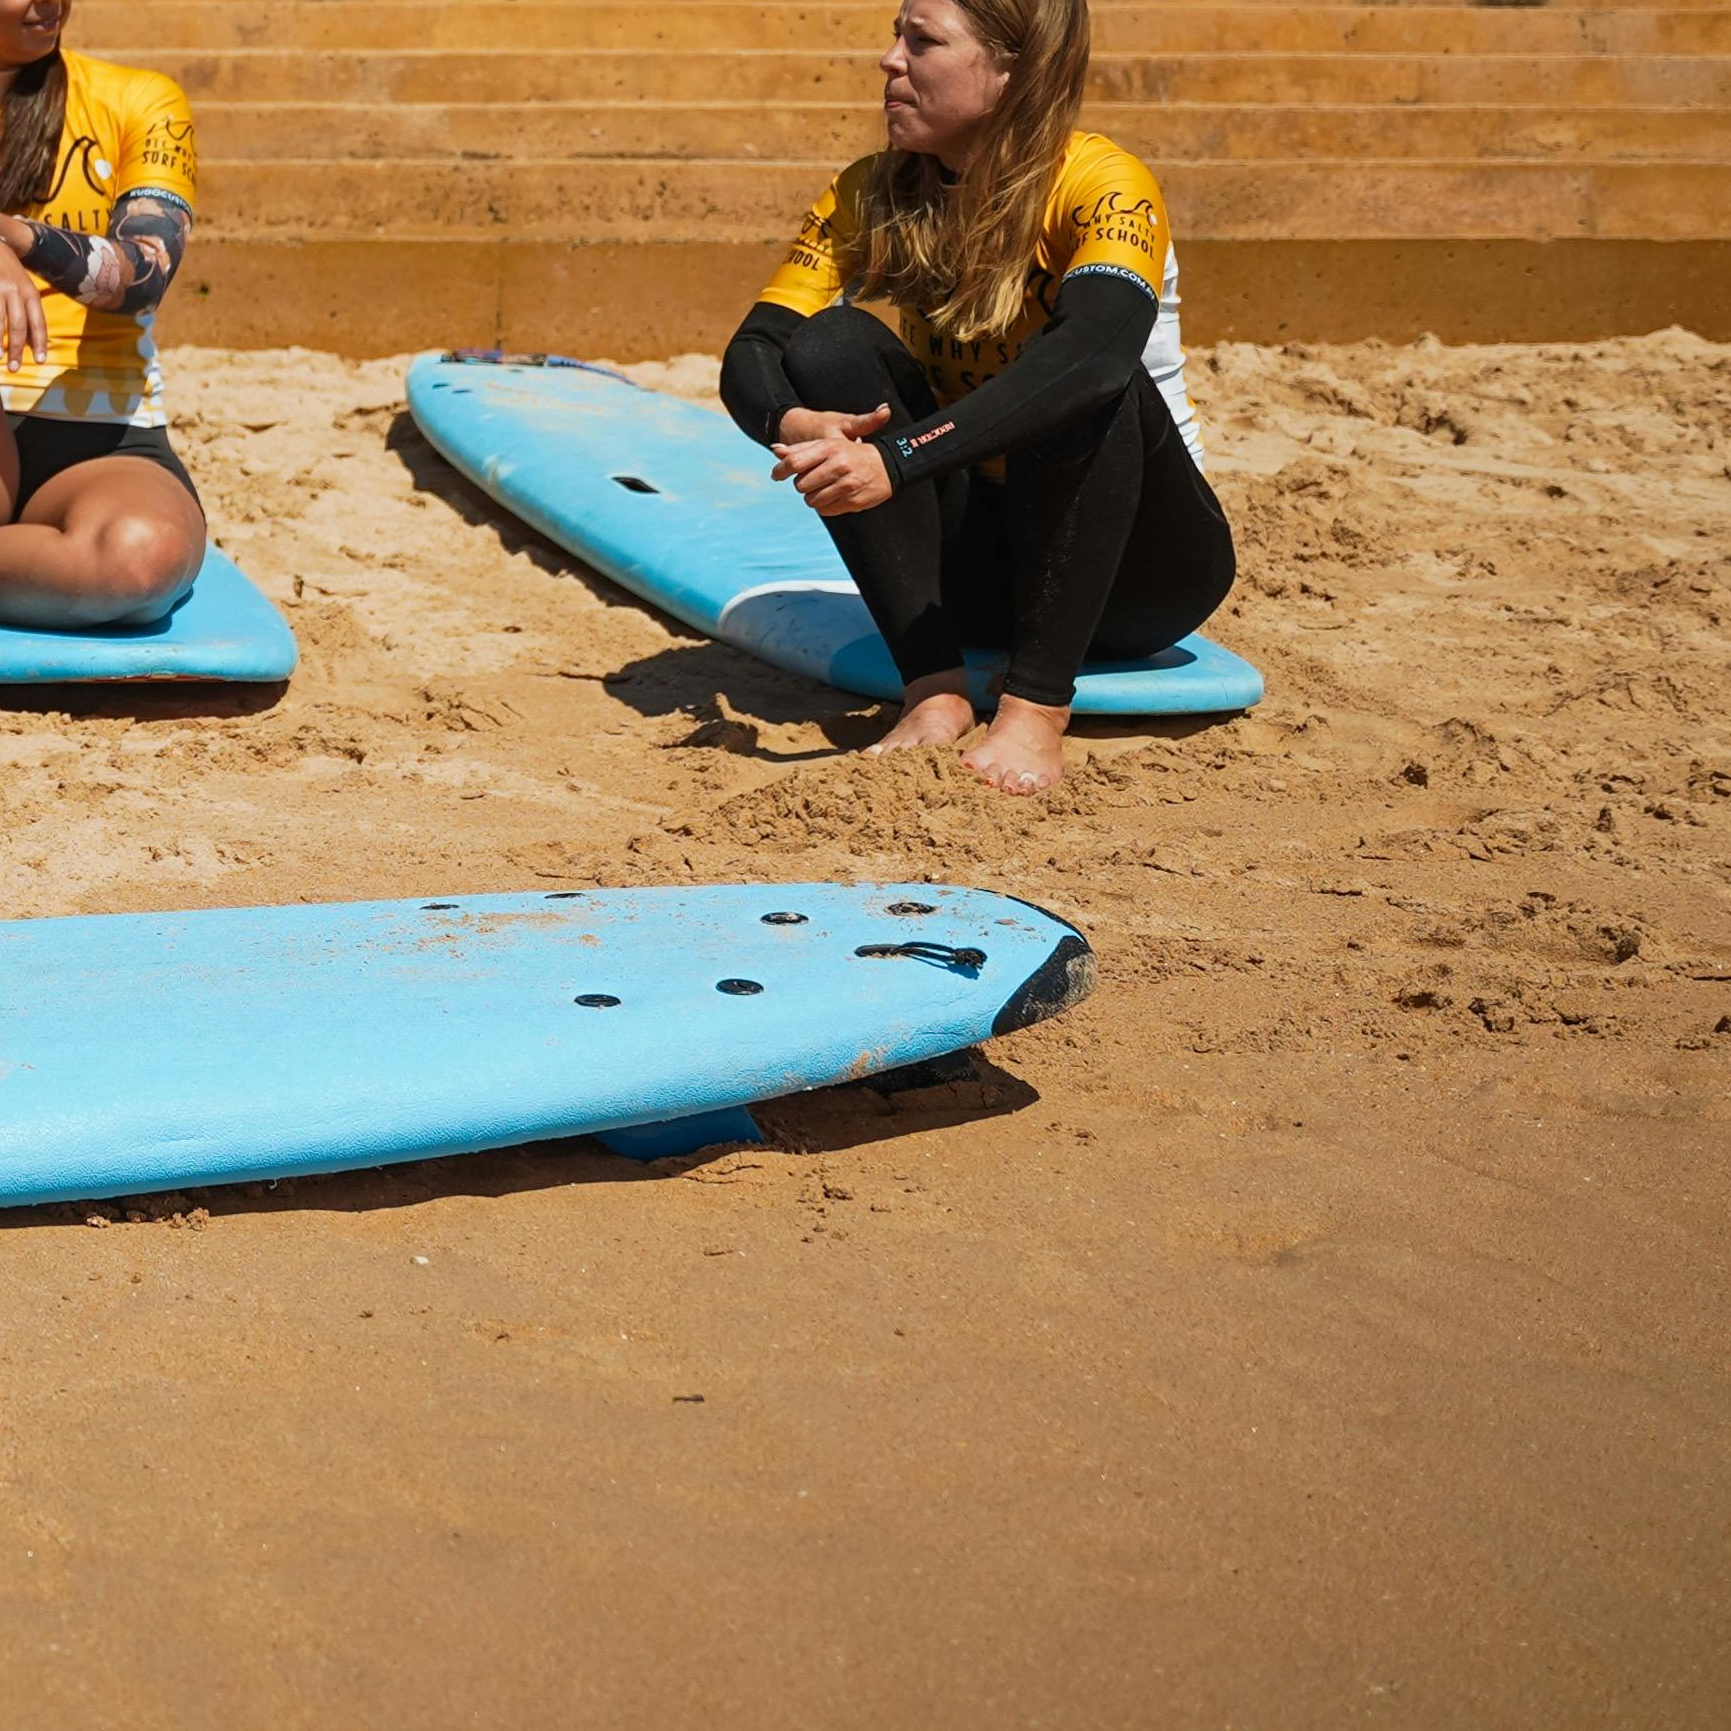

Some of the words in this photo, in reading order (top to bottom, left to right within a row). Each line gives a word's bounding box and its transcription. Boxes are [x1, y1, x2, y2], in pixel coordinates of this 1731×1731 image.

[141, 150, 177, 168] SURF
[1119, 216, 1155, 243] SALTY
[1095, 227, 1155, 261] SCHOOL
[929, 334, 982, 362] WHY
[896, 437, 914, 458] 3:2
